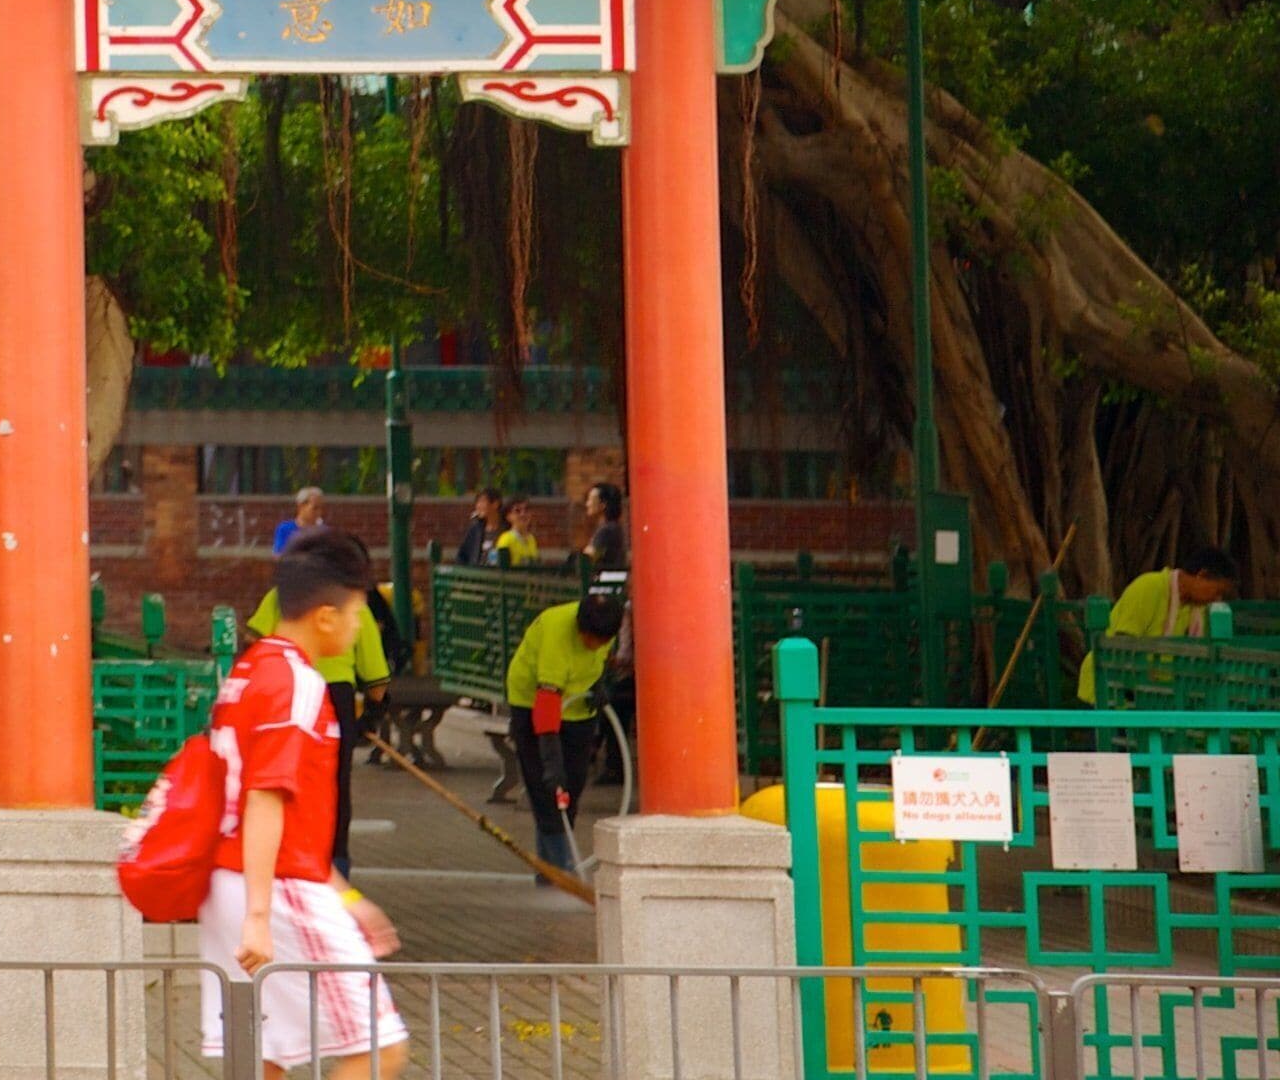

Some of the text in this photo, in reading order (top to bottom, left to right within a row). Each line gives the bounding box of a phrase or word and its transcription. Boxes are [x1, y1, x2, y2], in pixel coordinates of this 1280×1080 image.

[903, 810, 1002, 822] No dogs allowed
